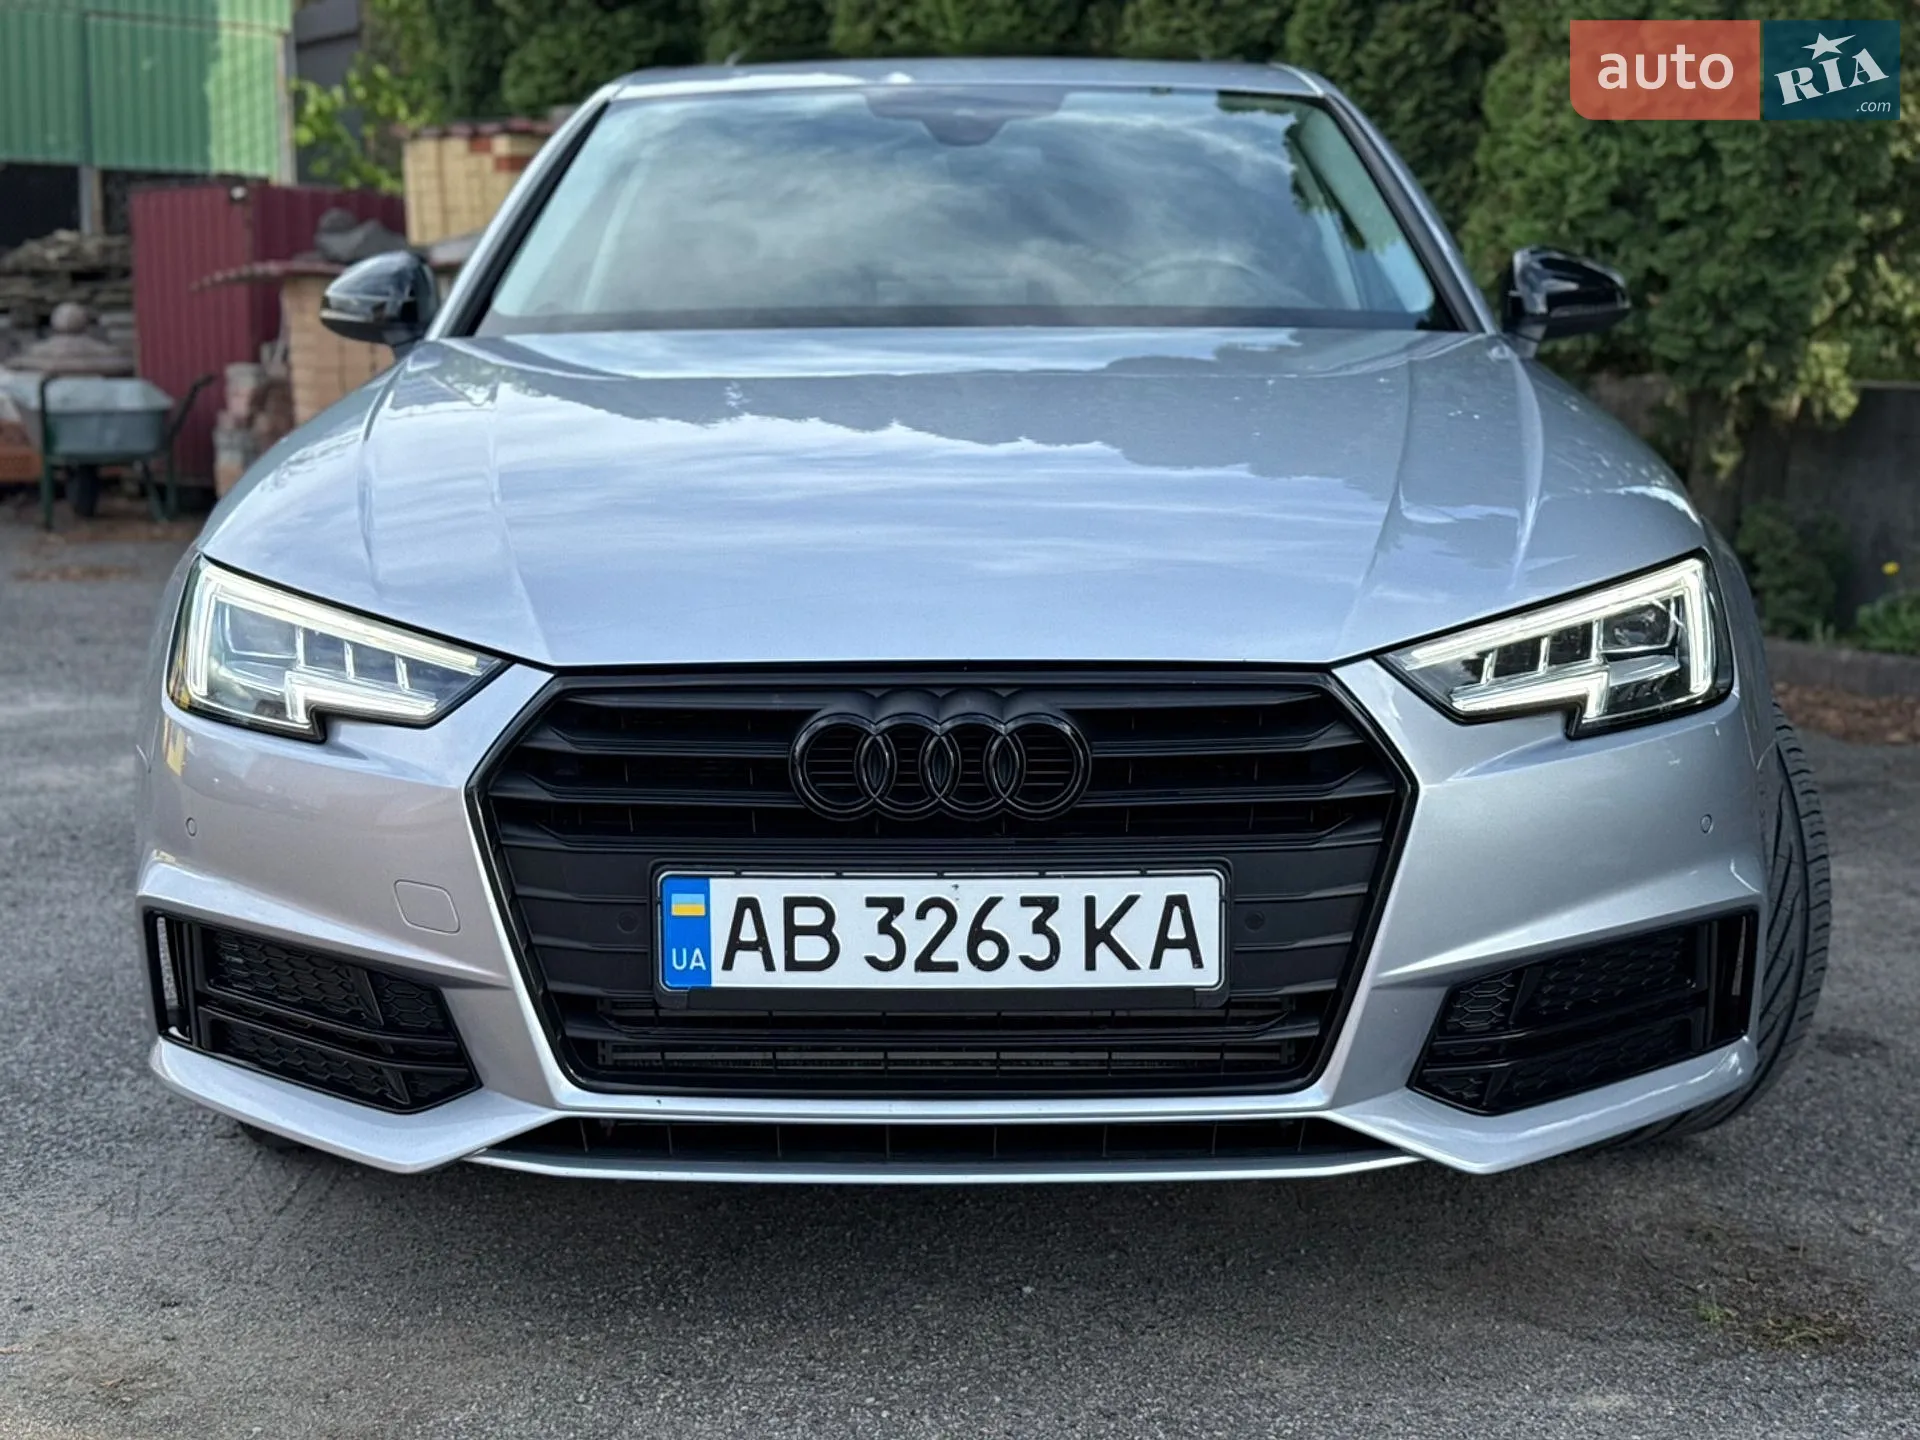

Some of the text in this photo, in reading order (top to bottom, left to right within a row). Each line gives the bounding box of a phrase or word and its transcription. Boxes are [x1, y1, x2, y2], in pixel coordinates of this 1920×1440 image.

[671, 947, 707, 971] UA
[721, 894, 1205, 973] AB 3263 KA
